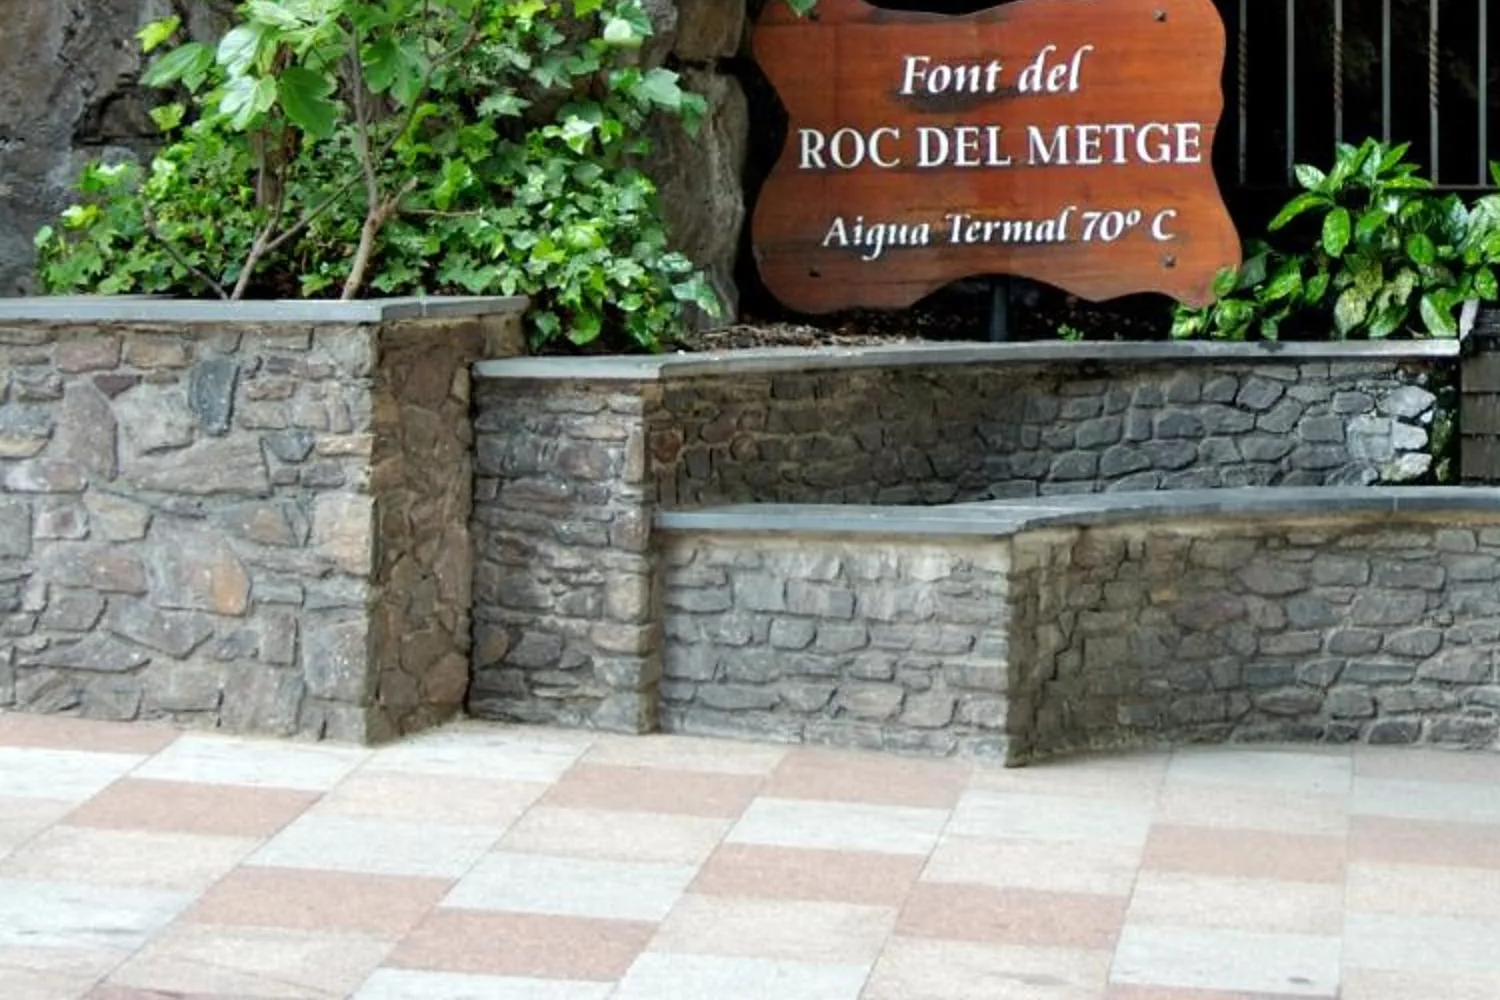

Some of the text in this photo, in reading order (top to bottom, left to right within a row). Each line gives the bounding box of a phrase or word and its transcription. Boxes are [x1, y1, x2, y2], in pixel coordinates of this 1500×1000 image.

[901, 45, 1095, 95] Font del
[799, 122, 1202, 169] ROC DEL METGE
[822, 216, 930, 261] Aigua
[945, 205, 1079, 244] Termal
[1151, 209, 1177, 241] C
